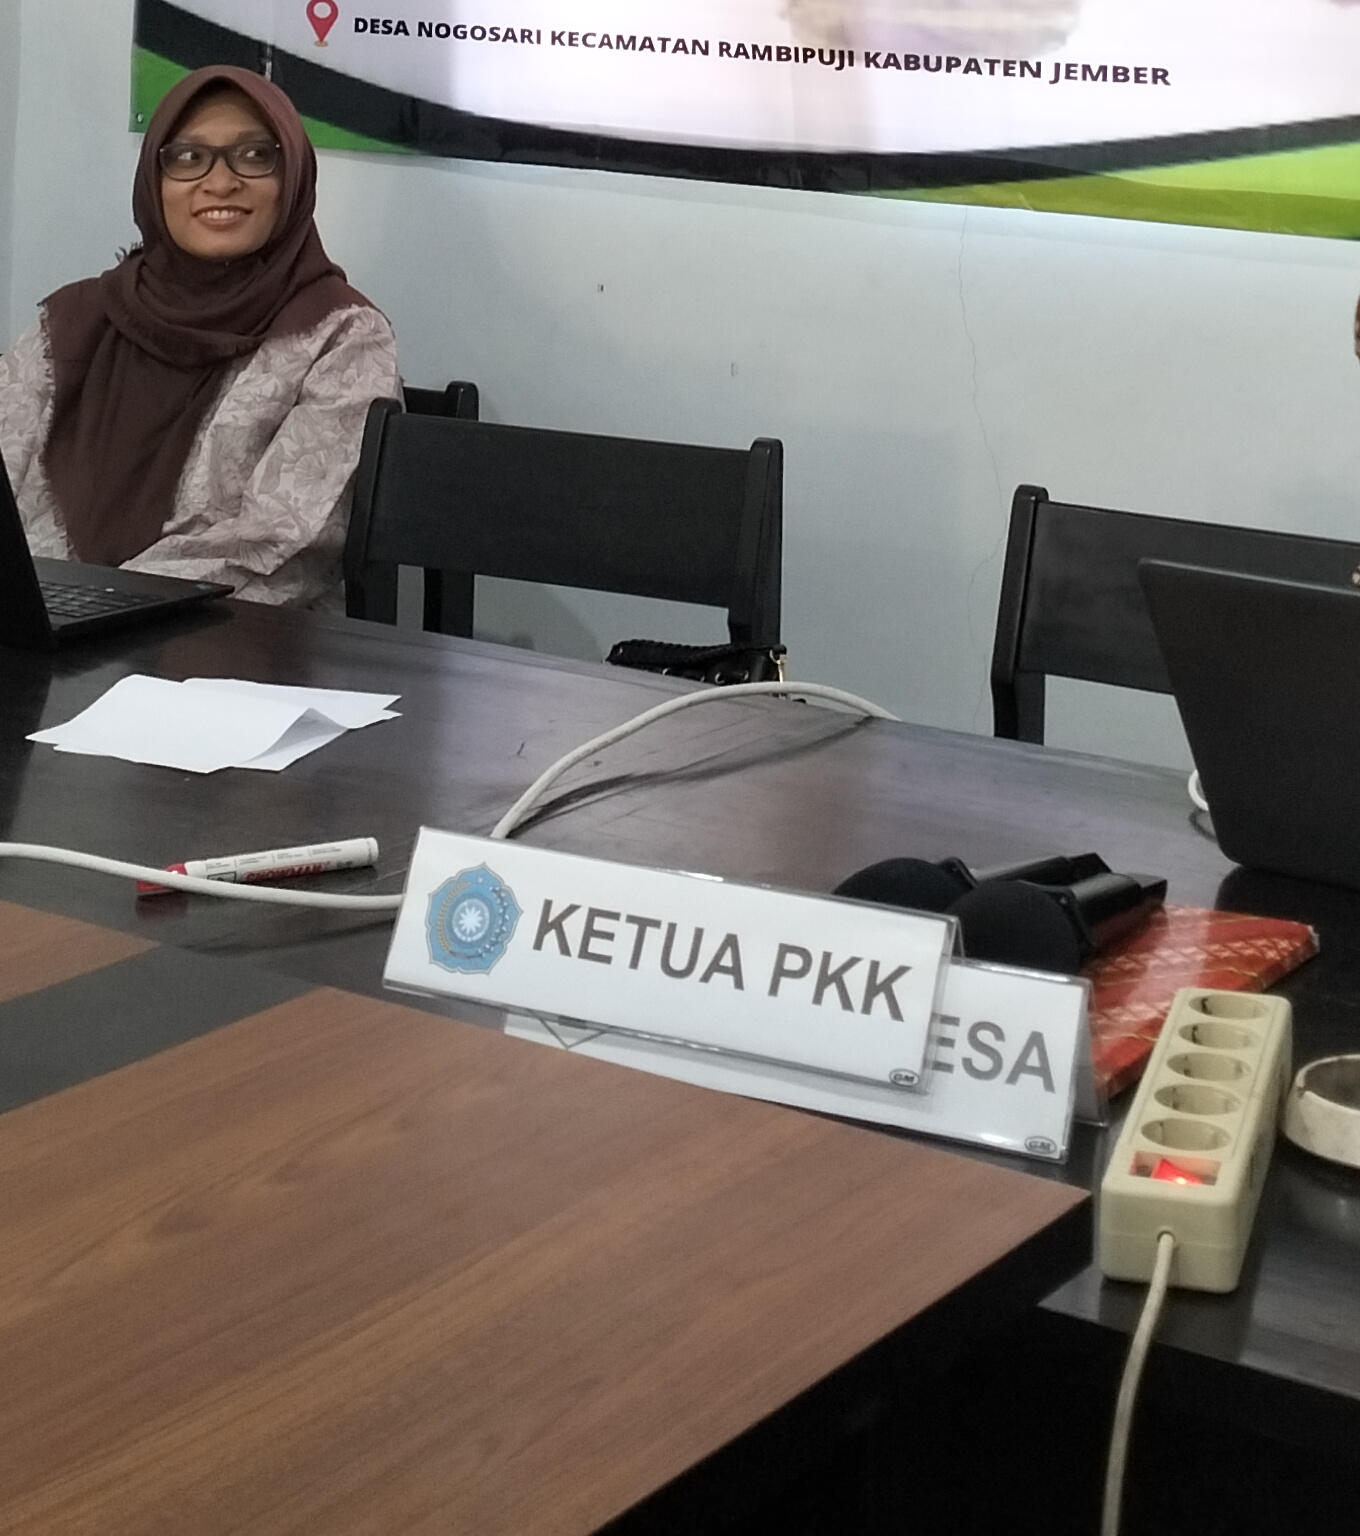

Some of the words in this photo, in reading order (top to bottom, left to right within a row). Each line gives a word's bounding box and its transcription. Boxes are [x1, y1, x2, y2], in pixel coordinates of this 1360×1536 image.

[353, 16, 411, 37] DESA
[416, 20, 542, 46] NOGOSARI
[550, 29, 710, 57] KECAMATAN
[717, 40, 857, 72] RAMBIPUJI
[863, 50, 1042, 79] KABUPATEN
[1048, 61, 1172, 87] JEMBER
[532, 898, 745, 992] KETUA
[767, 942, 913, 1023] PKK
[925, 1012, 1056, 1094] ESA
